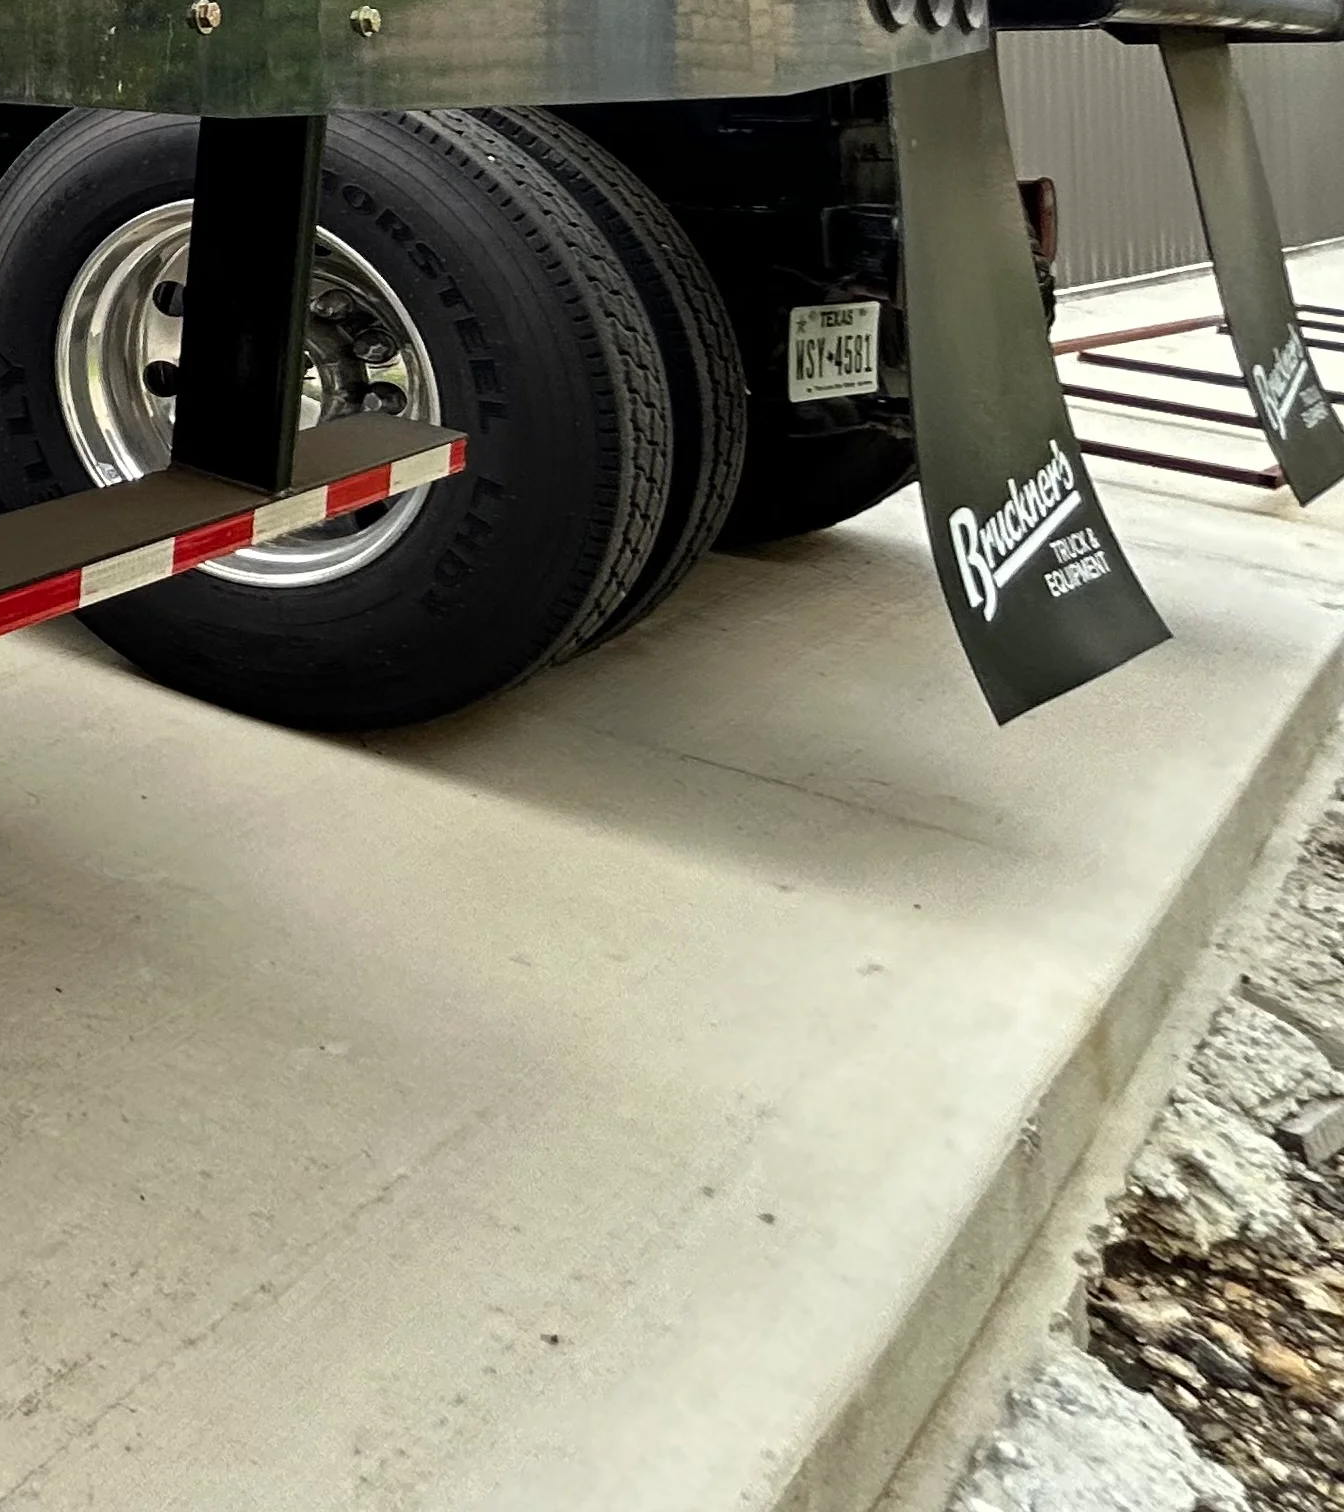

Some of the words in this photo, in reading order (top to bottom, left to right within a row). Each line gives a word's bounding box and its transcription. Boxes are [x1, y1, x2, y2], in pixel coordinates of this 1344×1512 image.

[948, 439, 1076, 622] Bruckner's
[1049, 529, 1092, 564] TRUCK
[1086, 527, 1102, 549] &
[1043, 550, 1112, 597] EQUIPMENT
